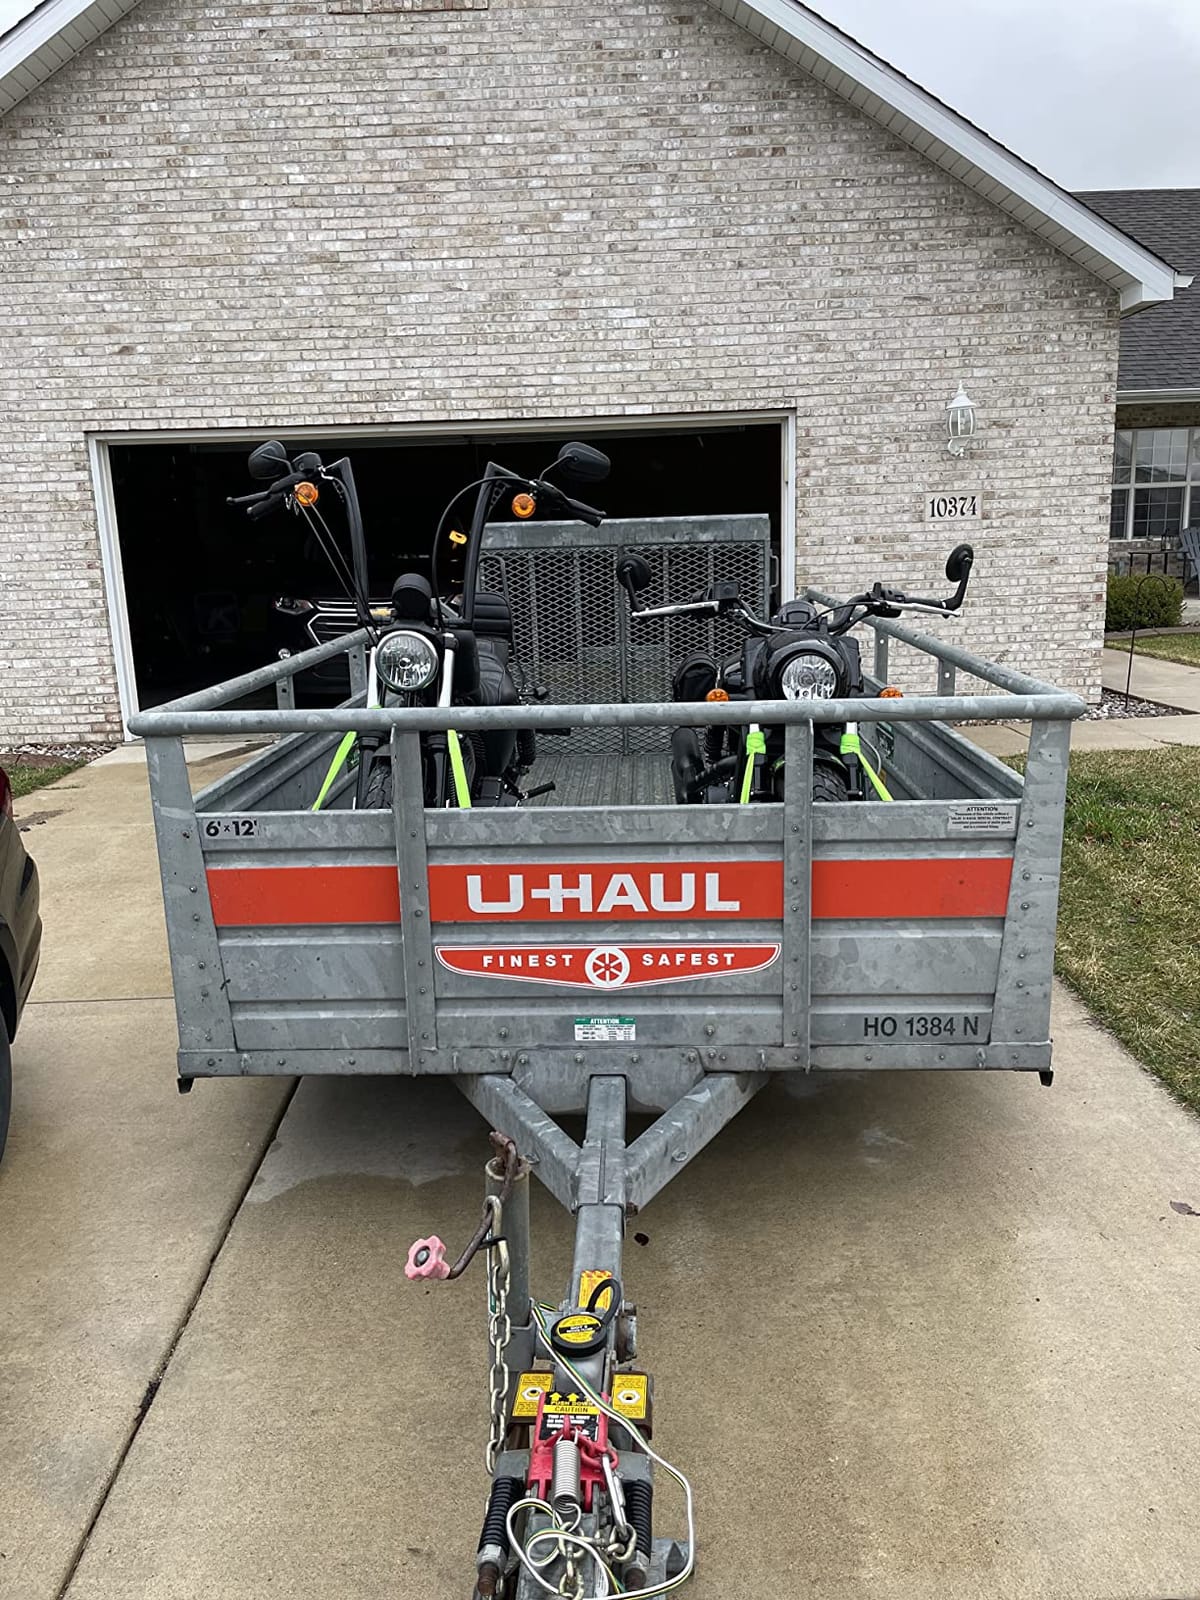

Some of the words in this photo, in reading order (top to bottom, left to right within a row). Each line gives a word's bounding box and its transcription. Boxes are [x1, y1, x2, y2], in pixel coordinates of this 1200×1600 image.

[929, 496, 977, 517] 10374
[465, 872, 741, 914] U-HAUL
[483, 954, 574, 969] FINEST
[642, 953, 736, 966] SAFEST
[864, 1016, 898, 1037] HO
[905, 1016, 956, 1036] 1384
[963, 1016, 979, 1036] N
